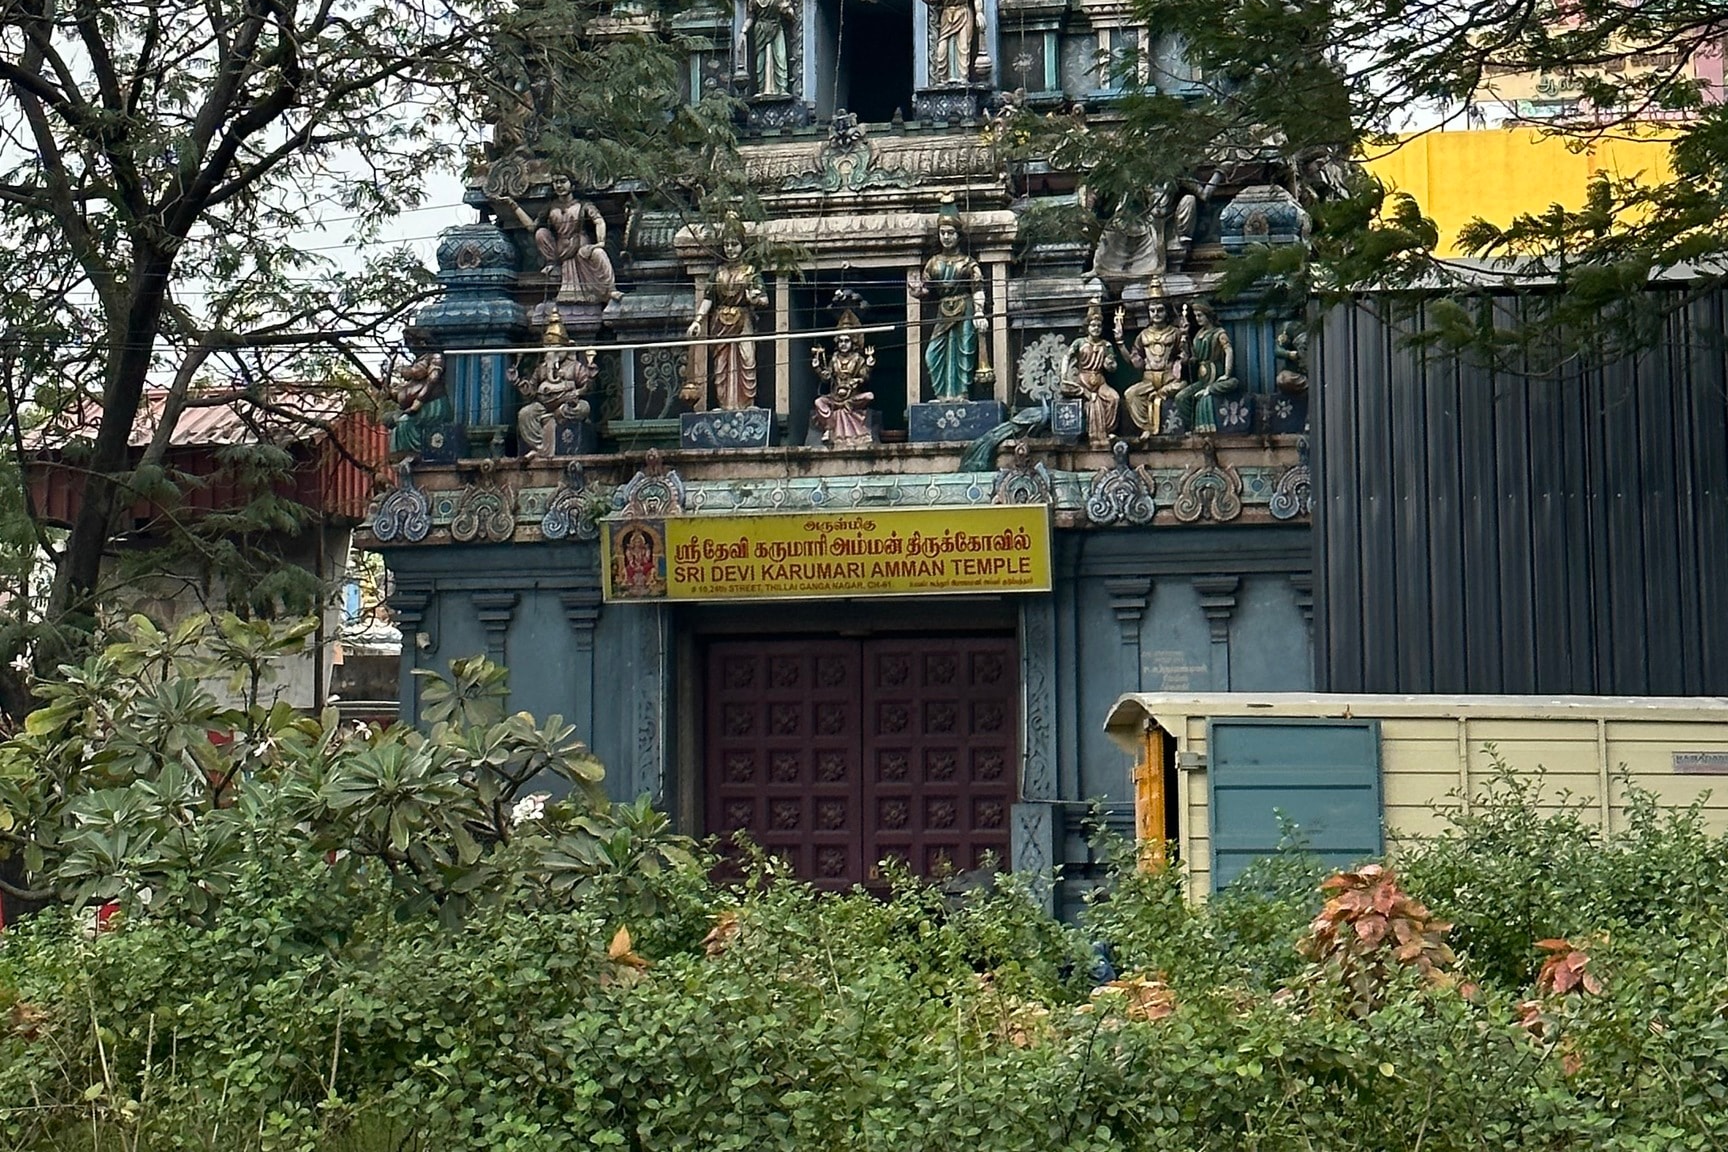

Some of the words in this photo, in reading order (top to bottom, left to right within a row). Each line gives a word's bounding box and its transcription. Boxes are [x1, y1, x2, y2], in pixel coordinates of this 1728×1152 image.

[803, 516, 877, 534] அருள்மிகு
[754, 533, 828, 563] கருமாரி
[830, 530, 903, 556] அம்மன்
[905, 526, 1032, 559] திருக்கோவில்
[674, 566, 705, 583] SRI
[711, 565, 755, 582] DEVI
[761, 563, 865, 581] KARUMARI
[871, 560, 945, 578] AMMAN
[950, 556, 1032, 576] TEMPLE
[765, 583, 798, 592] THILLAI
[800, 582, 831, 591] GANGA
